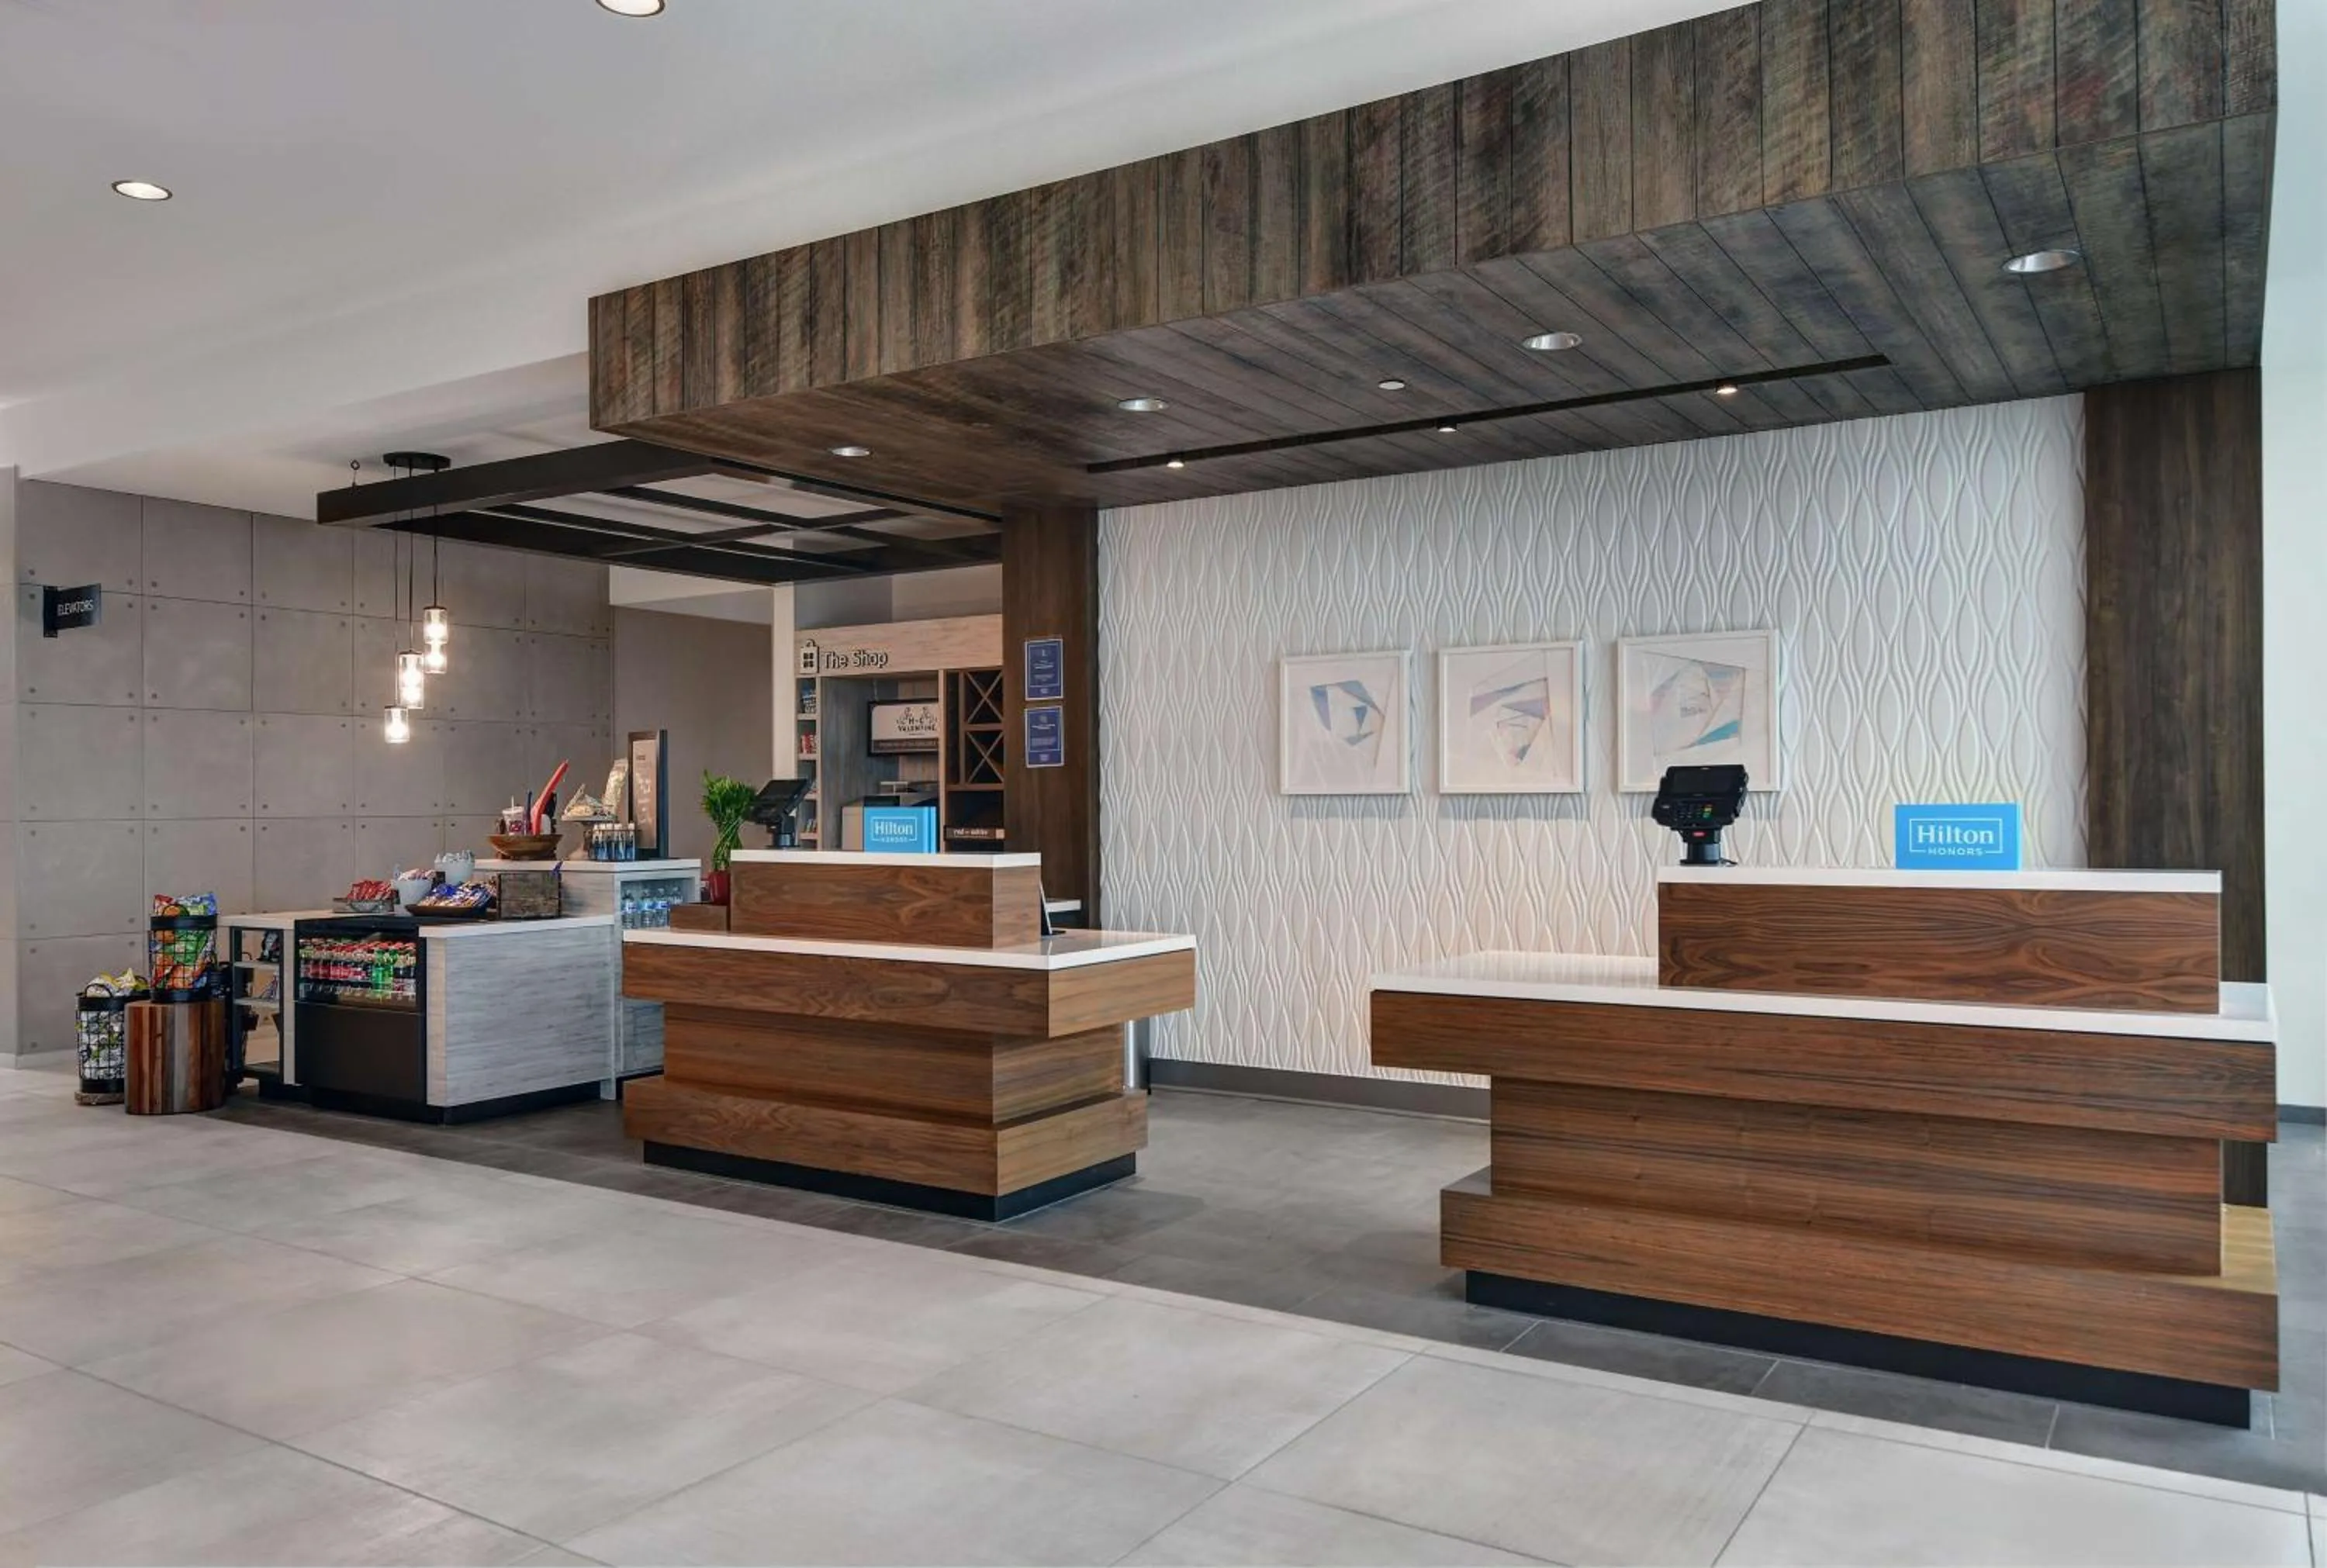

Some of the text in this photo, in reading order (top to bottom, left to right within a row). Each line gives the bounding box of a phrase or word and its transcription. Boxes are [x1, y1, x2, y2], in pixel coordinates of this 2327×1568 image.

[825, 649, 888, 668] The Shop
[874, 821, 914, 835] Hilton
[1917, 825, 1994, 844] Hilton
[1928, 847, 1983, 856] HONORS
